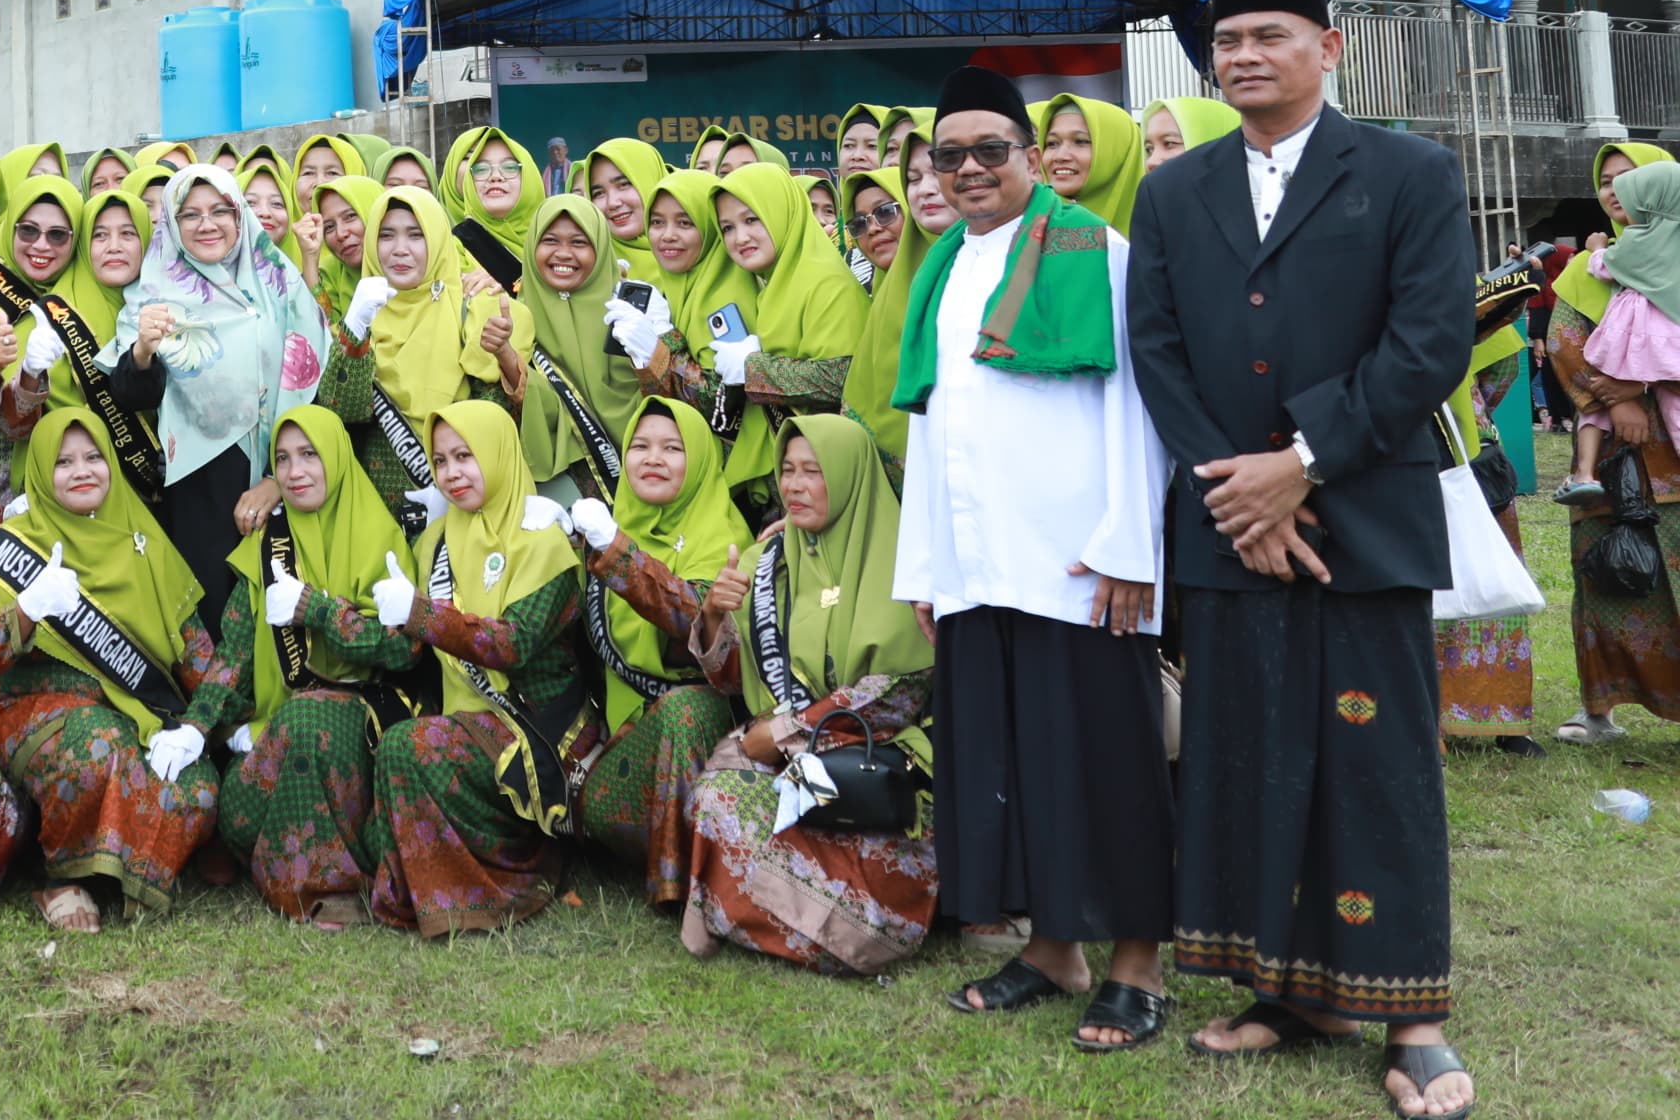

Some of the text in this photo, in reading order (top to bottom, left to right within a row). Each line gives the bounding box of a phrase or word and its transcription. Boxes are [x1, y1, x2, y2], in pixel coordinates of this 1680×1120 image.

[637, 114, 770, 144] GEBYAR
[57, 311, 104, 386] Muslimat
[95, 389, 134, 449] ranting
[74, 608, 149, 691] BUNGARAYA
[281, 625, 304, 682] anting
